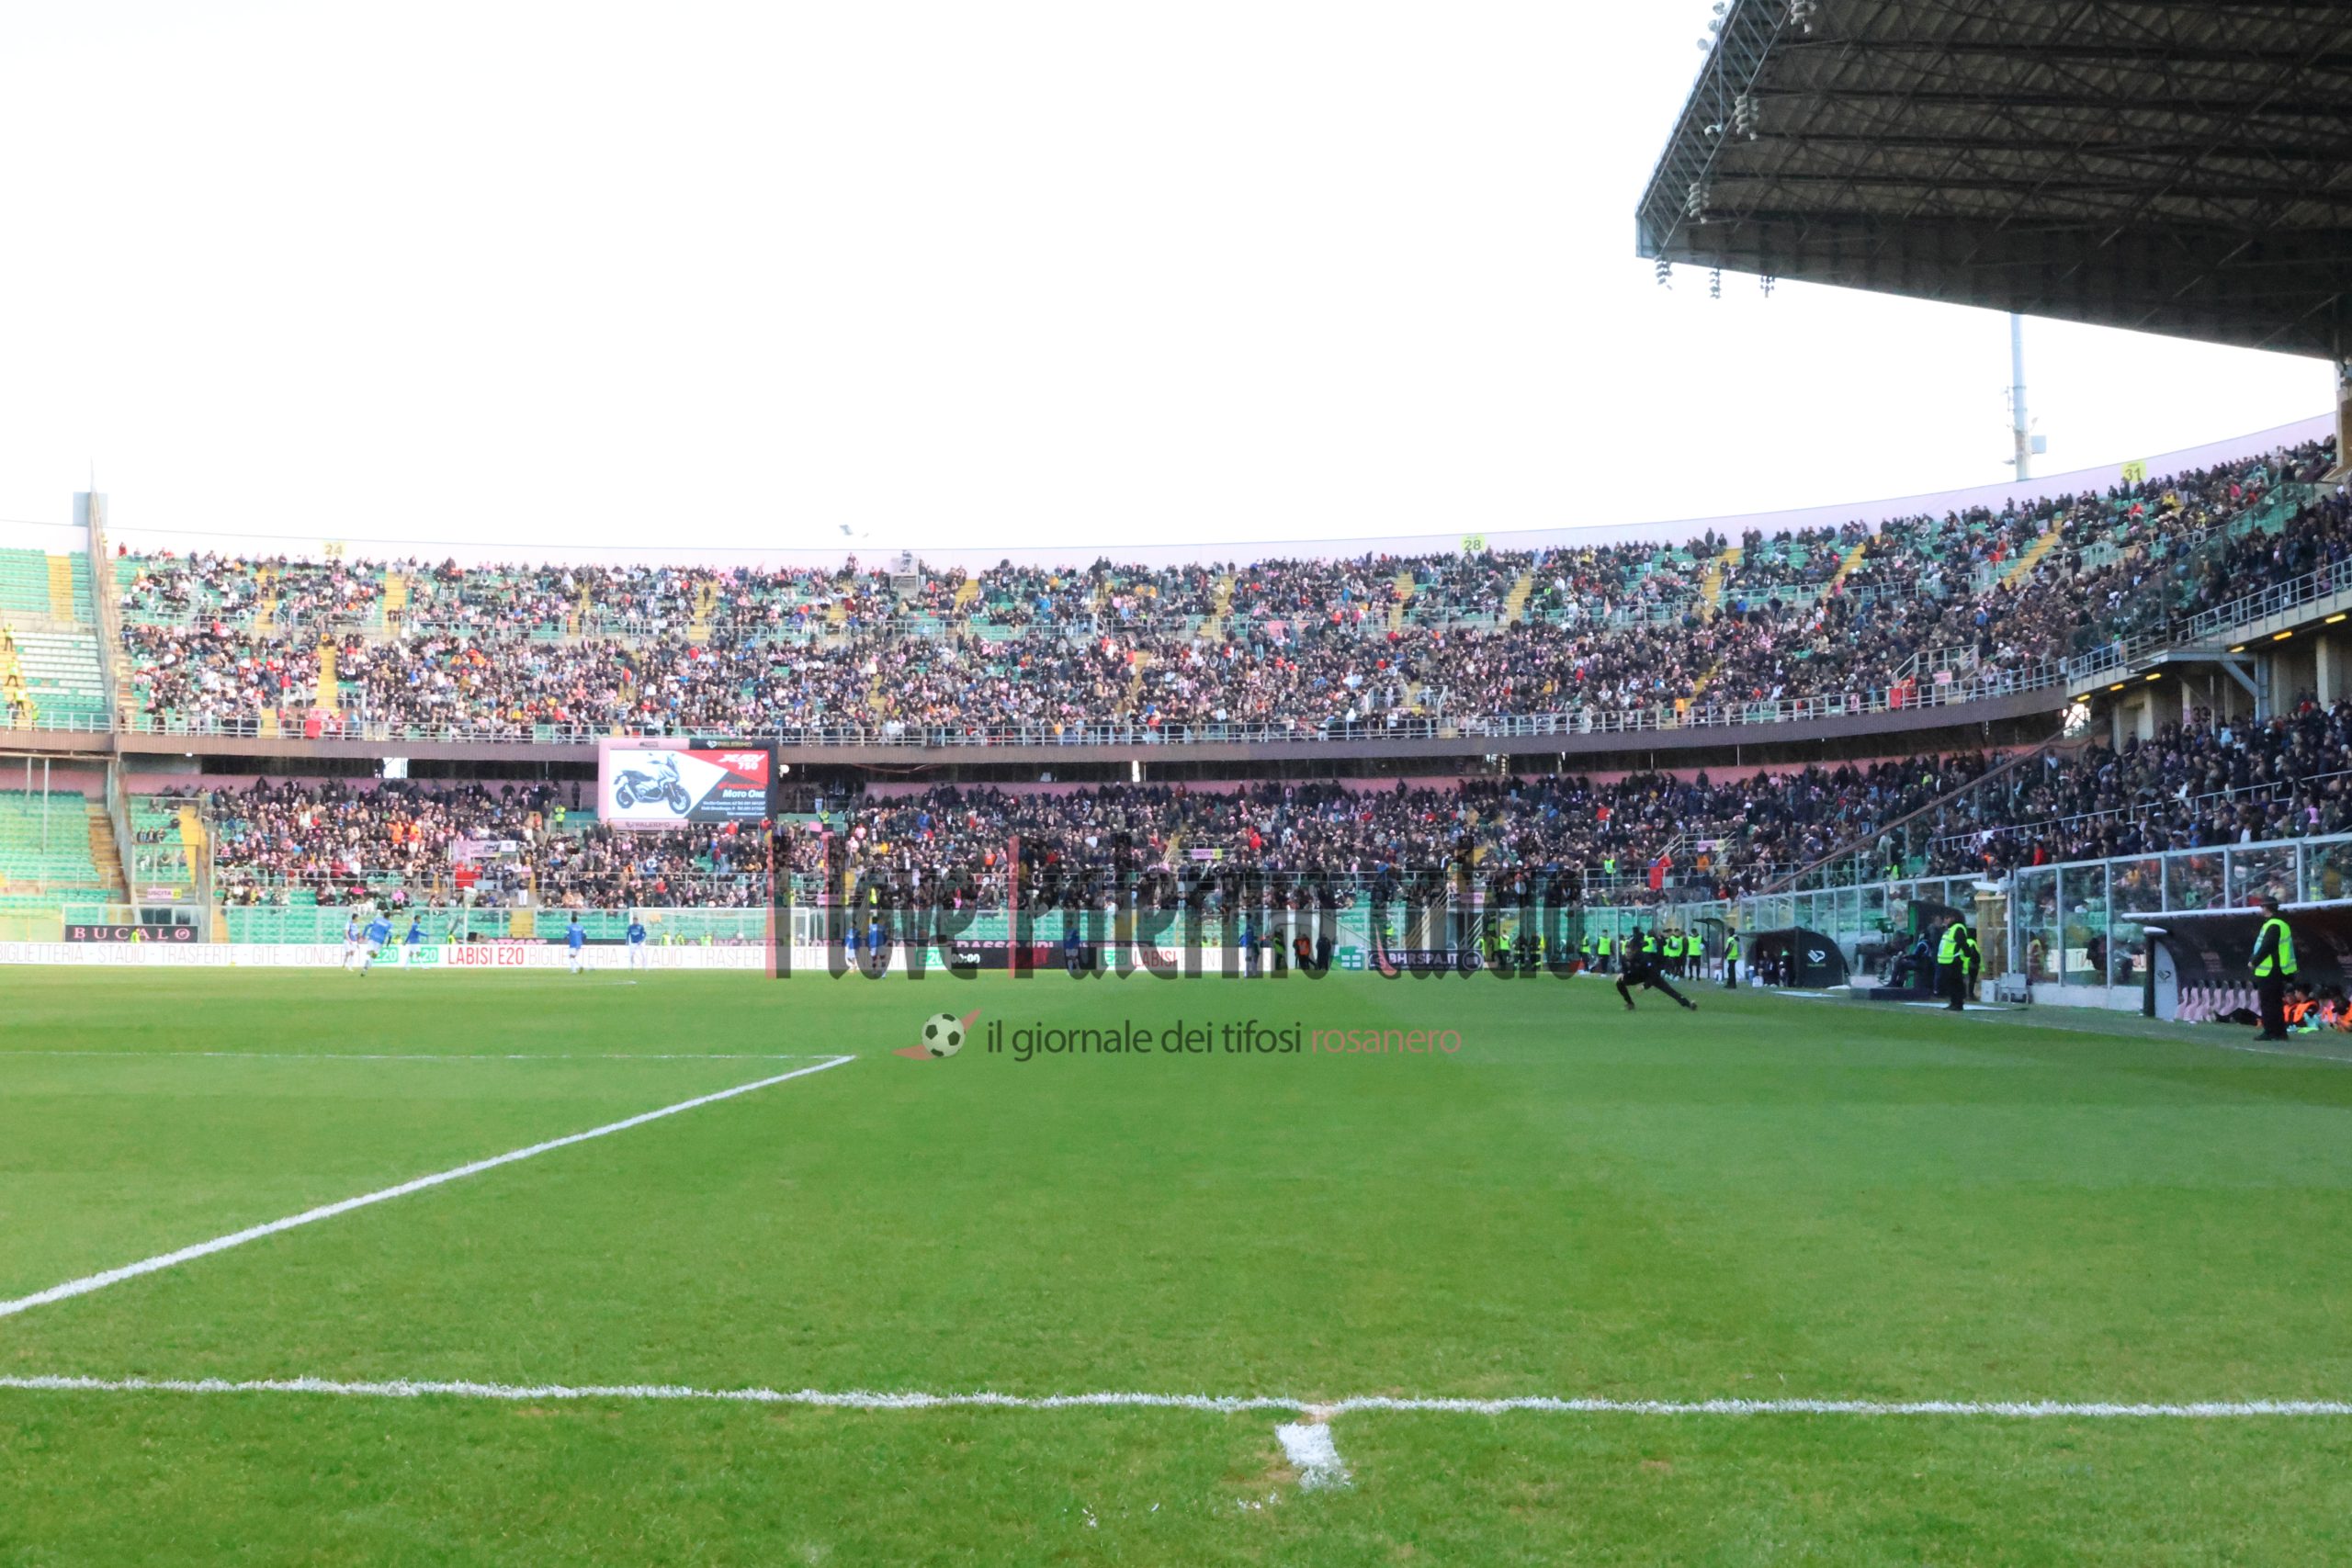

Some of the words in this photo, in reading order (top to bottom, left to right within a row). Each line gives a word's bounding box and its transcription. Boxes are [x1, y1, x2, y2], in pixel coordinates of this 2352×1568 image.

[2124, 468, 2141, 482] 31
[324, 543, 342, 555] 24
[1464, 539, 1481, 550] 28
[738, 761, 758, 770] 750
[97, 944, 146, 964] STADIO
[160, 945, 236, 964] TRASFERTE
[252, 946, 280, 964] GITE
[448, 946, 492, 965] LABISI
[498, 947, 525, 965] E20
[1134, 950, 1177, 968] LABISI
